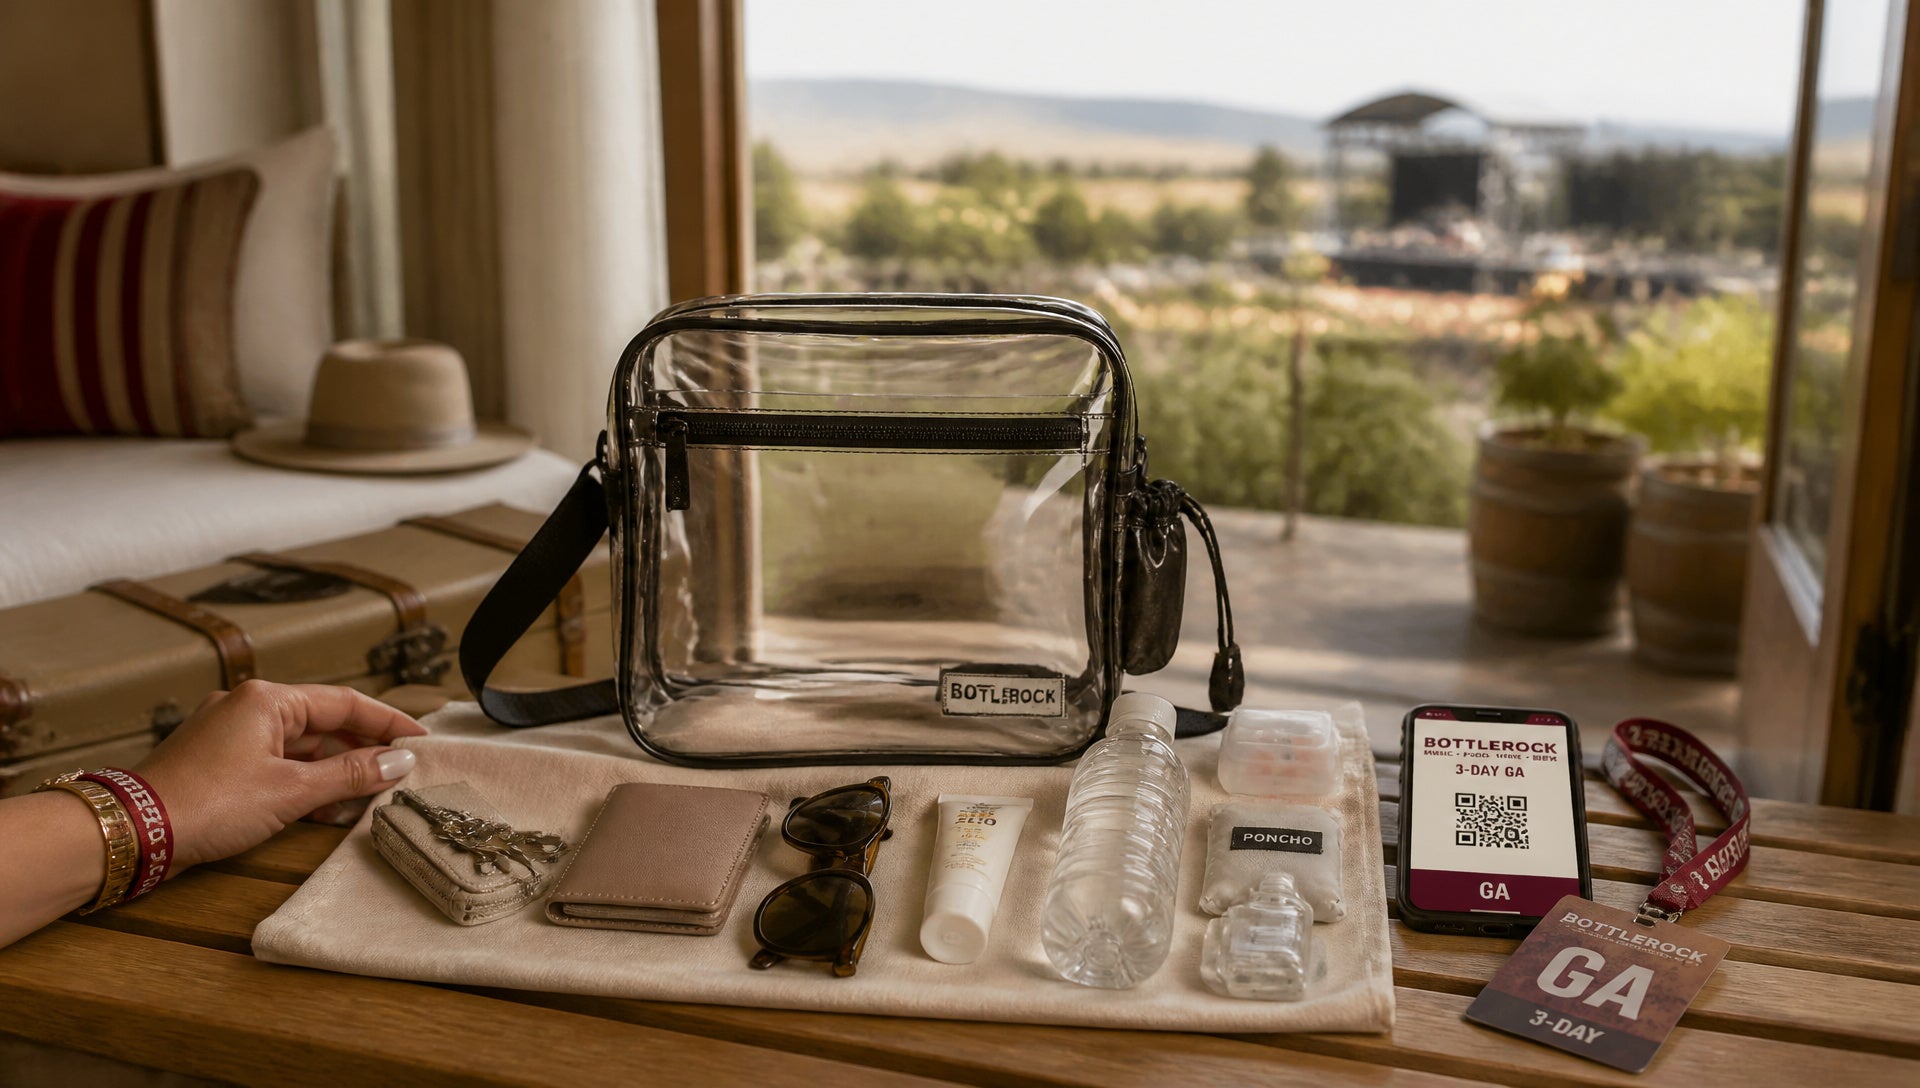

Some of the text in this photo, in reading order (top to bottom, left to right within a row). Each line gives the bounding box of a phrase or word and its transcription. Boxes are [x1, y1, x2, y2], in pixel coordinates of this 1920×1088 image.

[1424, 737, 1557, 754] BOTTLEROCK
[1456, 764, 1525, 778] 3-DAY GA
[1243, 833, 1313, 846] PONCHO
[1479, 882, 1510, 900] GA
[1560, 912, 1707, 964] BOTTLEROCK
[1537, 946, 1655, 1021] GA
[1529, 1009, 1605, 1044] 3-DAY
